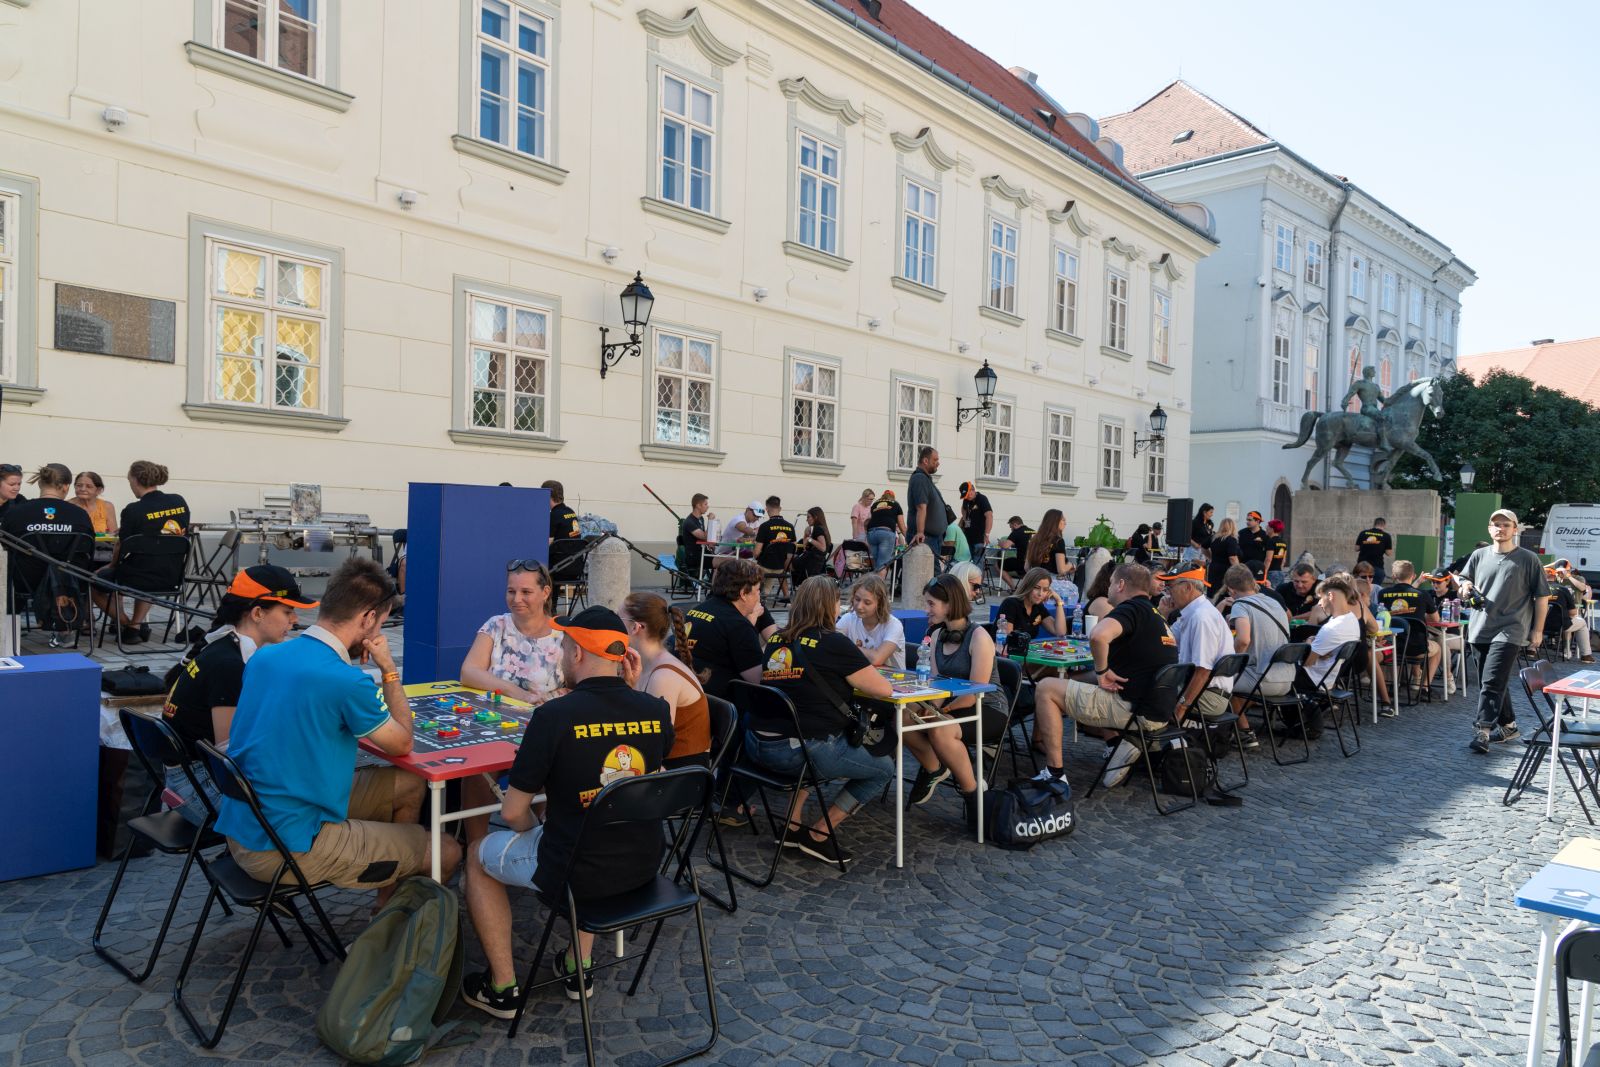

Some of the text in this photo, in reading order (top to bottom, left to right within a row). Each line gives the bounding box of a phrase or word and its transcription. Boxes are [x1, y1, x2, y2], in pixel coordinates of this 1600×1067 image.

[147, 507, 185, 520] REFEREE
[26, 523, 72, 533] GORSIUM
[1555, 526, 1588, 535] Ghibli
[573, 720, 662, 739] REFEREE
[1015, 811, 1072, 837] adidas
